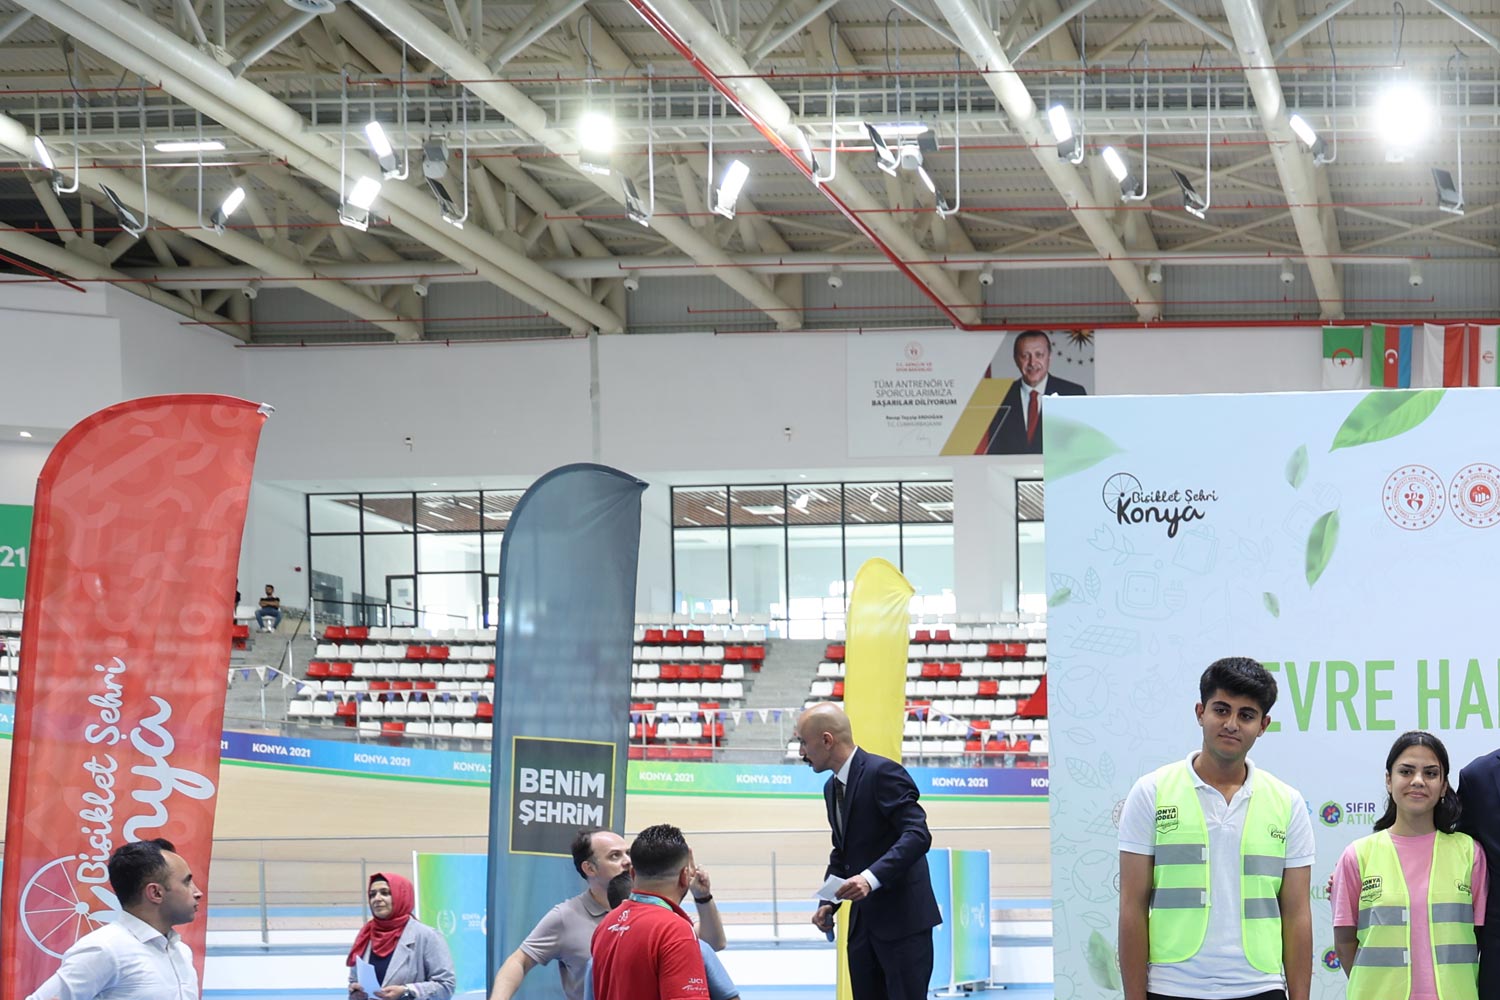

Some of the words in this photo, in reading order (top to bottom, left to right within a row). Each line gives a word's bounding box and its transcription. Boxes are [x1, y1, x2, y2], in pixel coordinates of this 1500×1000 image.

[873, 379, 894, 389] TÜM
[895, 379, 943, 389] ANTRENÖR
[944, 379, 955, 388] VE
[871, 399, 914, 407] BAŞARILAR
[1184, 489, 1218, 505] Şehri
[1117, 497, 1205, 539] Konya
[252, 742, 288, 756] KONYA
[289, 747, 311, 758] 2021
[353, 753, 388, 766] KONYA
[389, 756, 412, 768] 2021
[453, 760, 486, 773] KONYA
[638, 771, 673, 783] KONYA
[673, 772, 695, 783] 2021
[736, 773, 770, 784] KONYA
[771, 774, 793, 785] 2021
[931, 777, 966, 788] KONYA
[967, 777, 989, 788] 2021
[1345, 802, 1376, 813] SIFIR
[1346, 813, 1376, 825] ATIK
